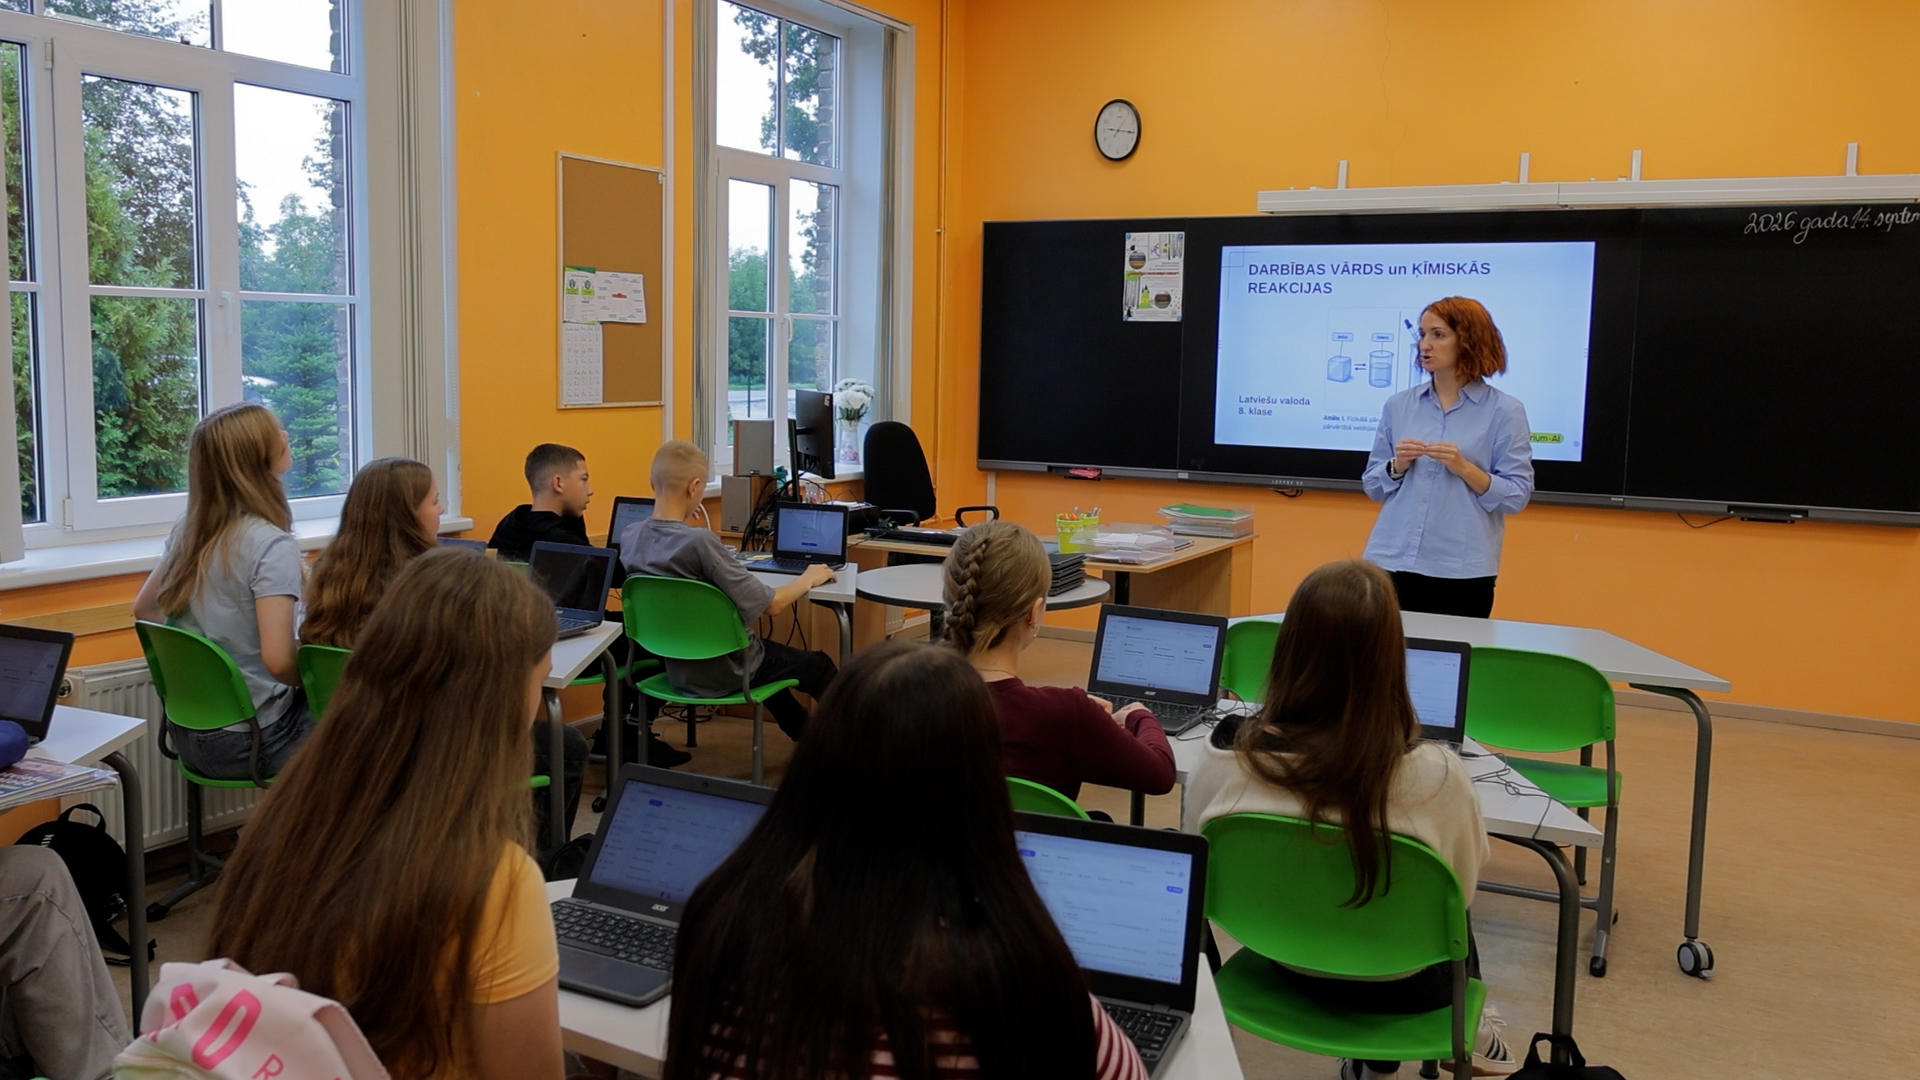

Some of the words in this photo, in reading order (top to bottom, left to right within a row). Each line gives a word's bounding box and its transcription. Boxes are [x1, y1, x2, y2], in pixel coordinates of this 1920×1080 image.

[1793, 211, 1848, 244] gada
[1248, 261, 1326, 276] DARBĪBAS
[1330, 261, 1384, 275] VĀRDS
[1388, 265, 1407, 275] un
[1412, 260, 1491, 278] ĶĪMISKĀS
[1248, 282, 1333, 294] REAKCIJAS
[1238, 396, 1277, 404] Latviešu
[1280, 397, 1311, 405] valoda
[1238, 406, 1246, 415] 8.
[1249, 407, 1273, 416] klase
